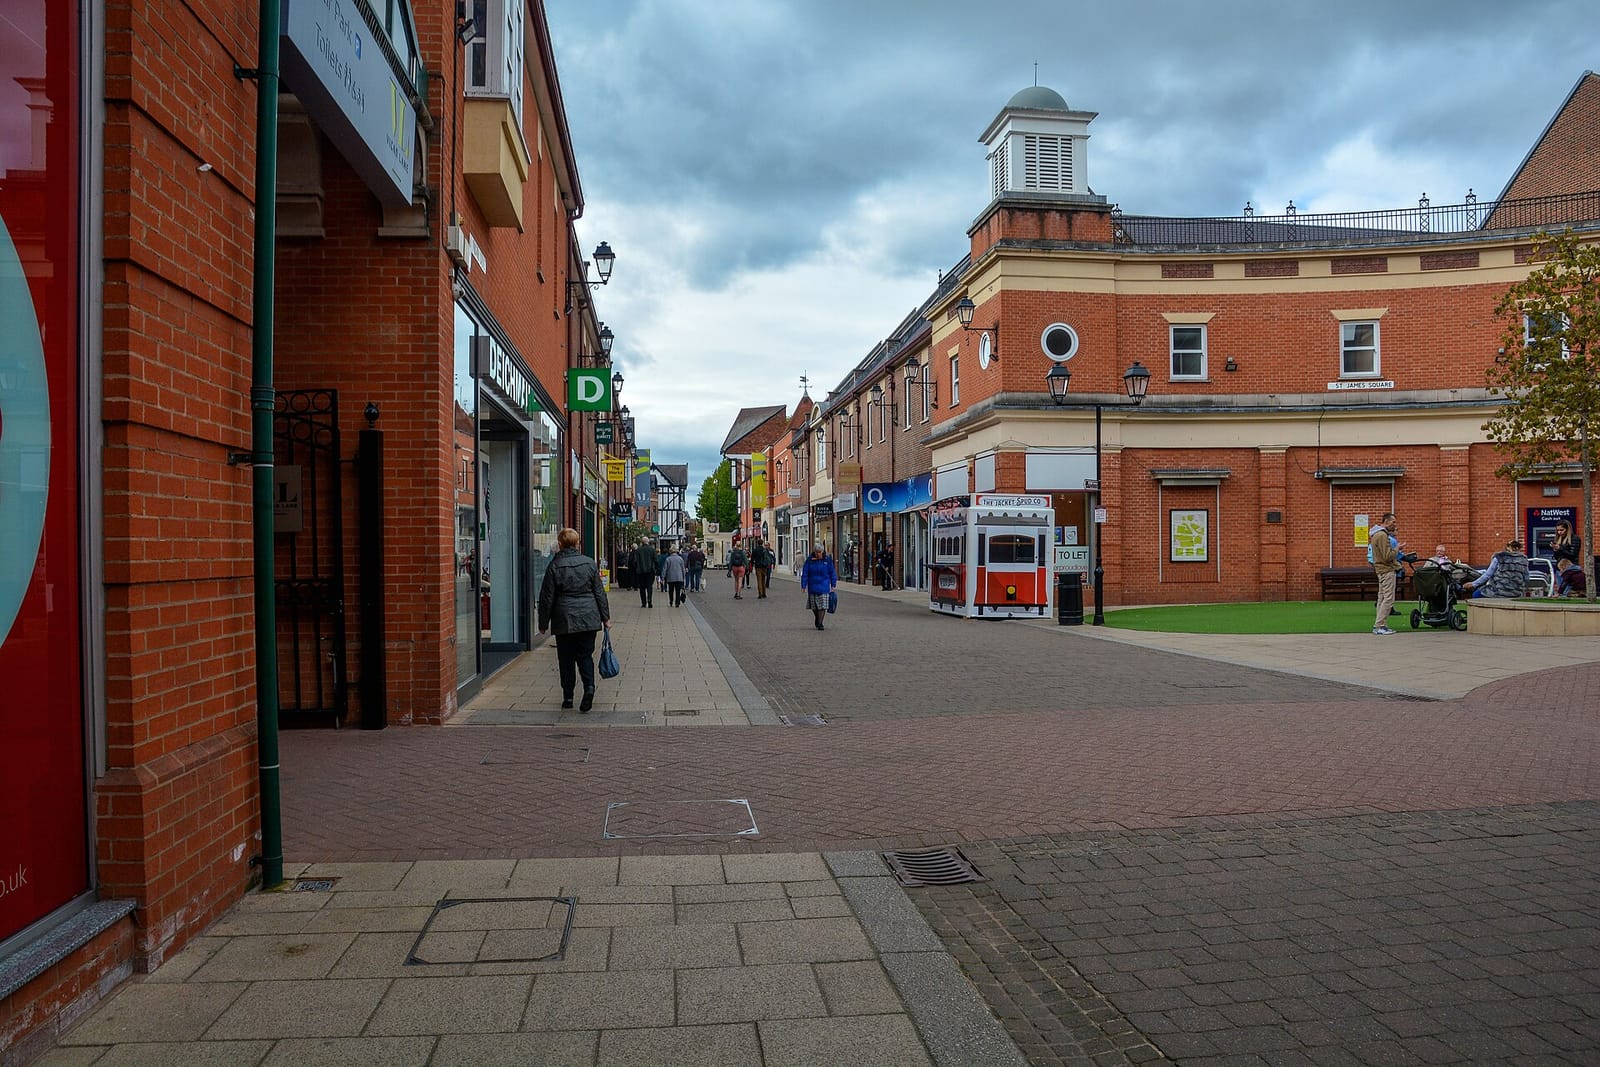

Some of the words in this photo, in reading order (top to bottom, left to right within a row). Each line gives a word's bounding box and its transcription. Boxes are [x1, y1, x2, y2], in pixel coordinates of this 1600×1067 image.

[315, 22, 342, 80] Toilets
[577, 375, 605, 403] D
[995, 499, 1015, 507] JACKET
[1058, 551, 1070, 560] TO
[1072, 551, 1087, 560] LET
